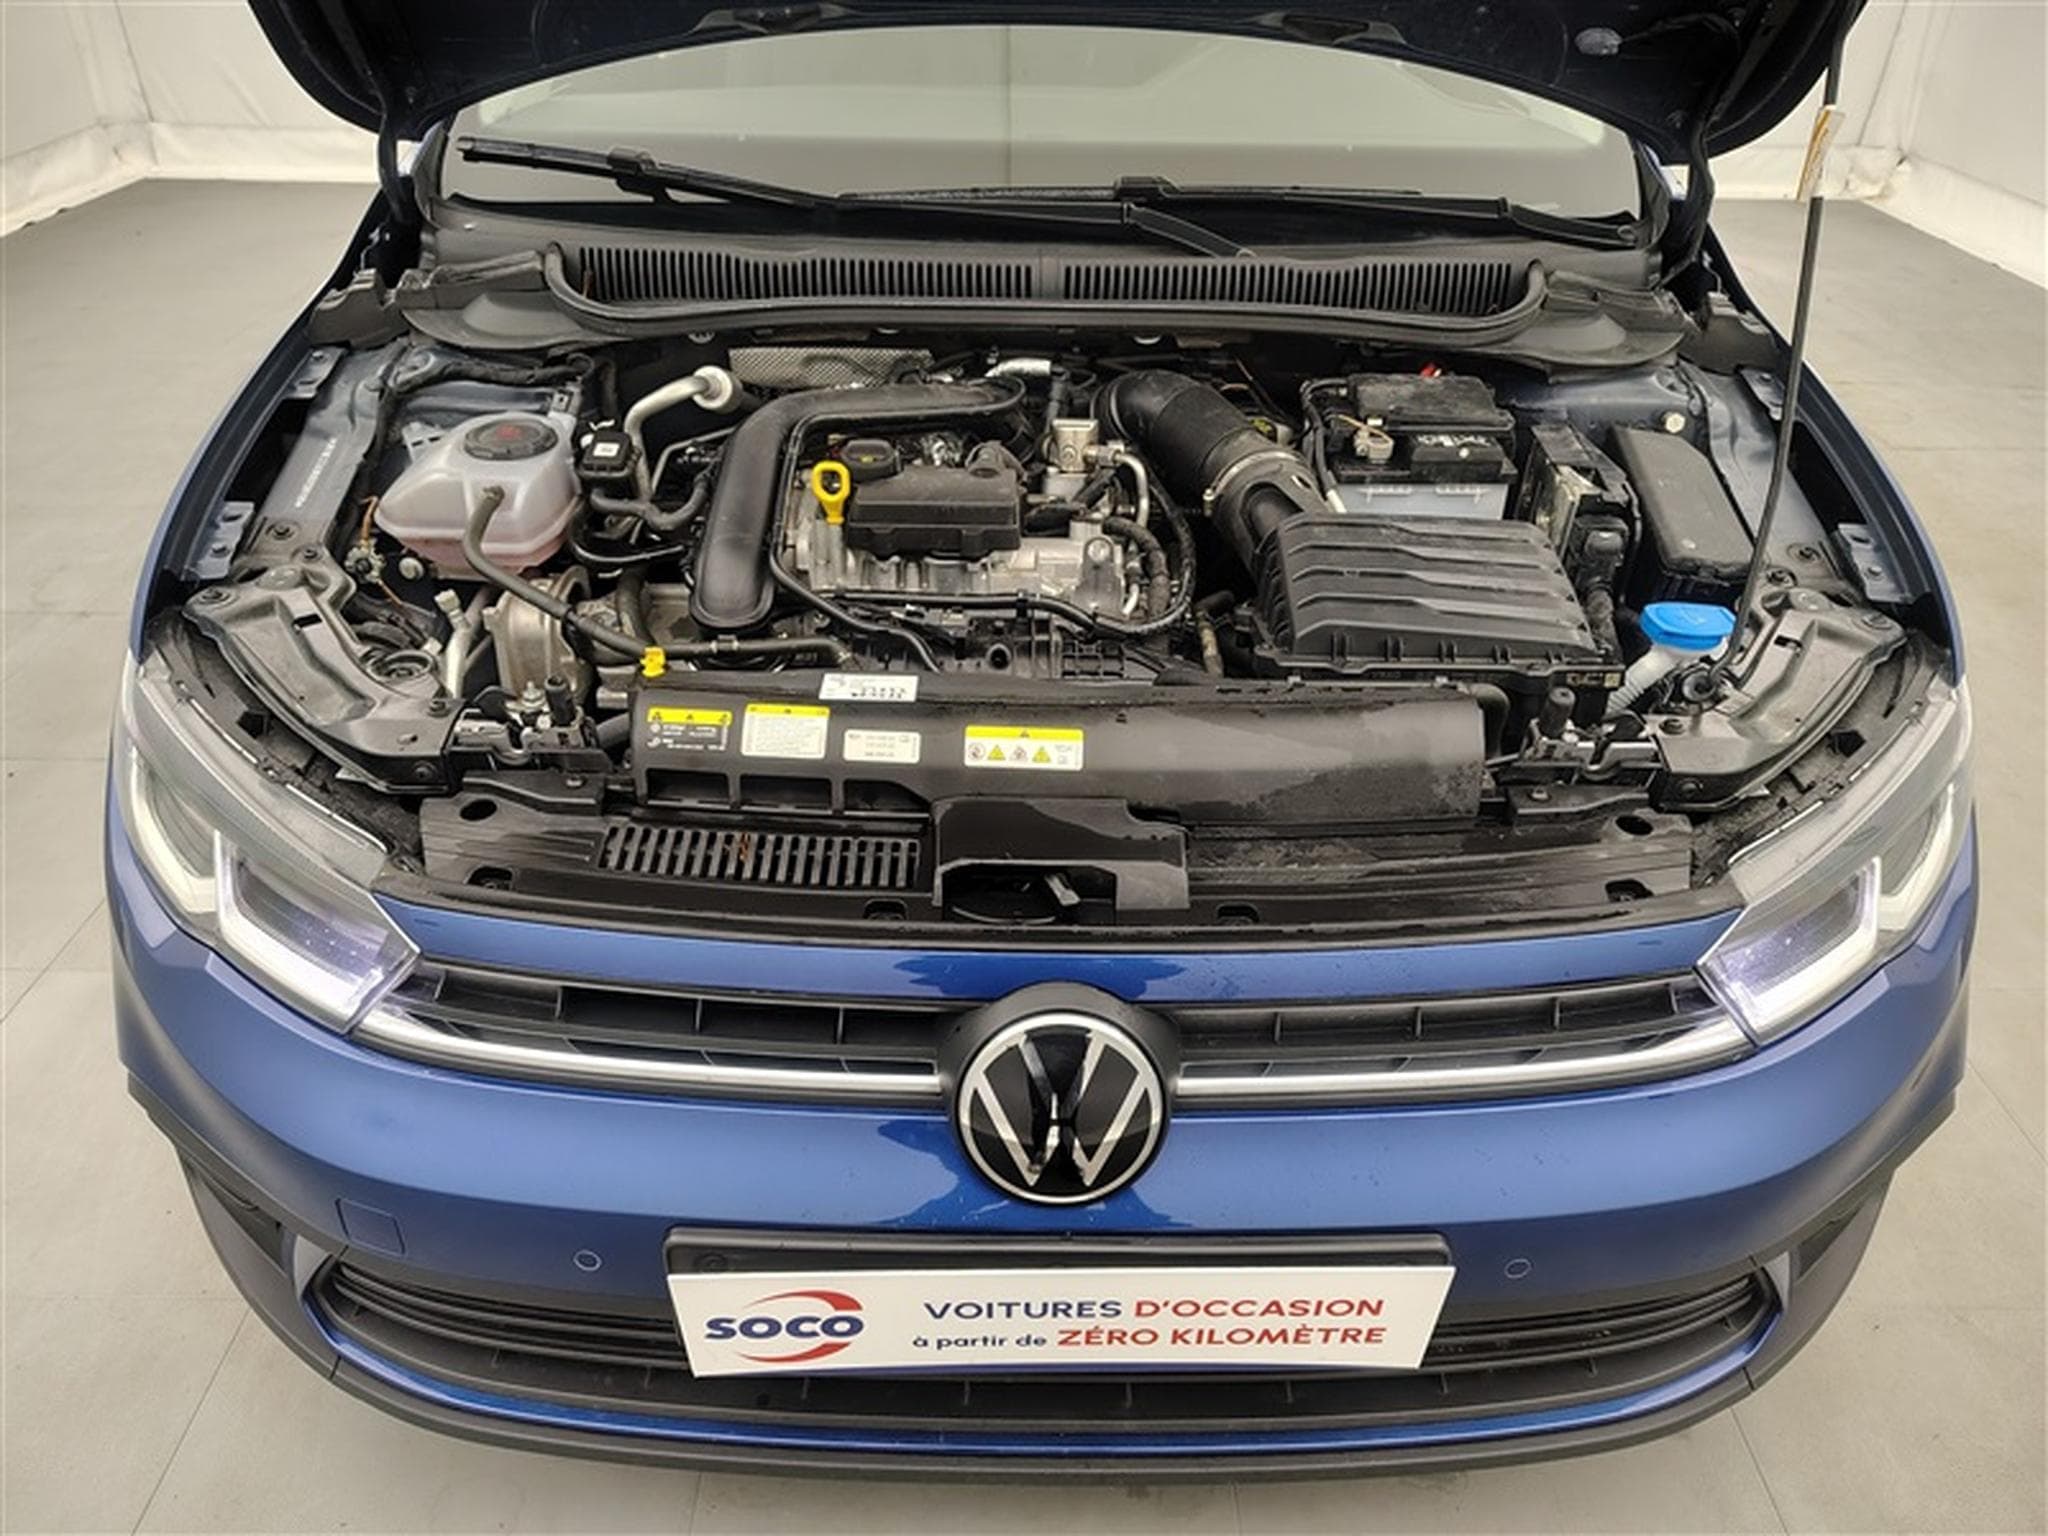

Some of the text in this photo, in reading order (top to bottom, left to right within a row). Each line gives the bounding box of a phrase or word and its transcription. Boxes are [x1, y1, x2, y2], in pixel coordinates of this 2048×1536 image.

[925, 1299, 1384, 1320] VOITURES D'OCCASION
[706, 1315, 864, 1341] SOCO
[912, 1323, 1387, 1353] à partir de ZÉRO KILOMÈTRE
